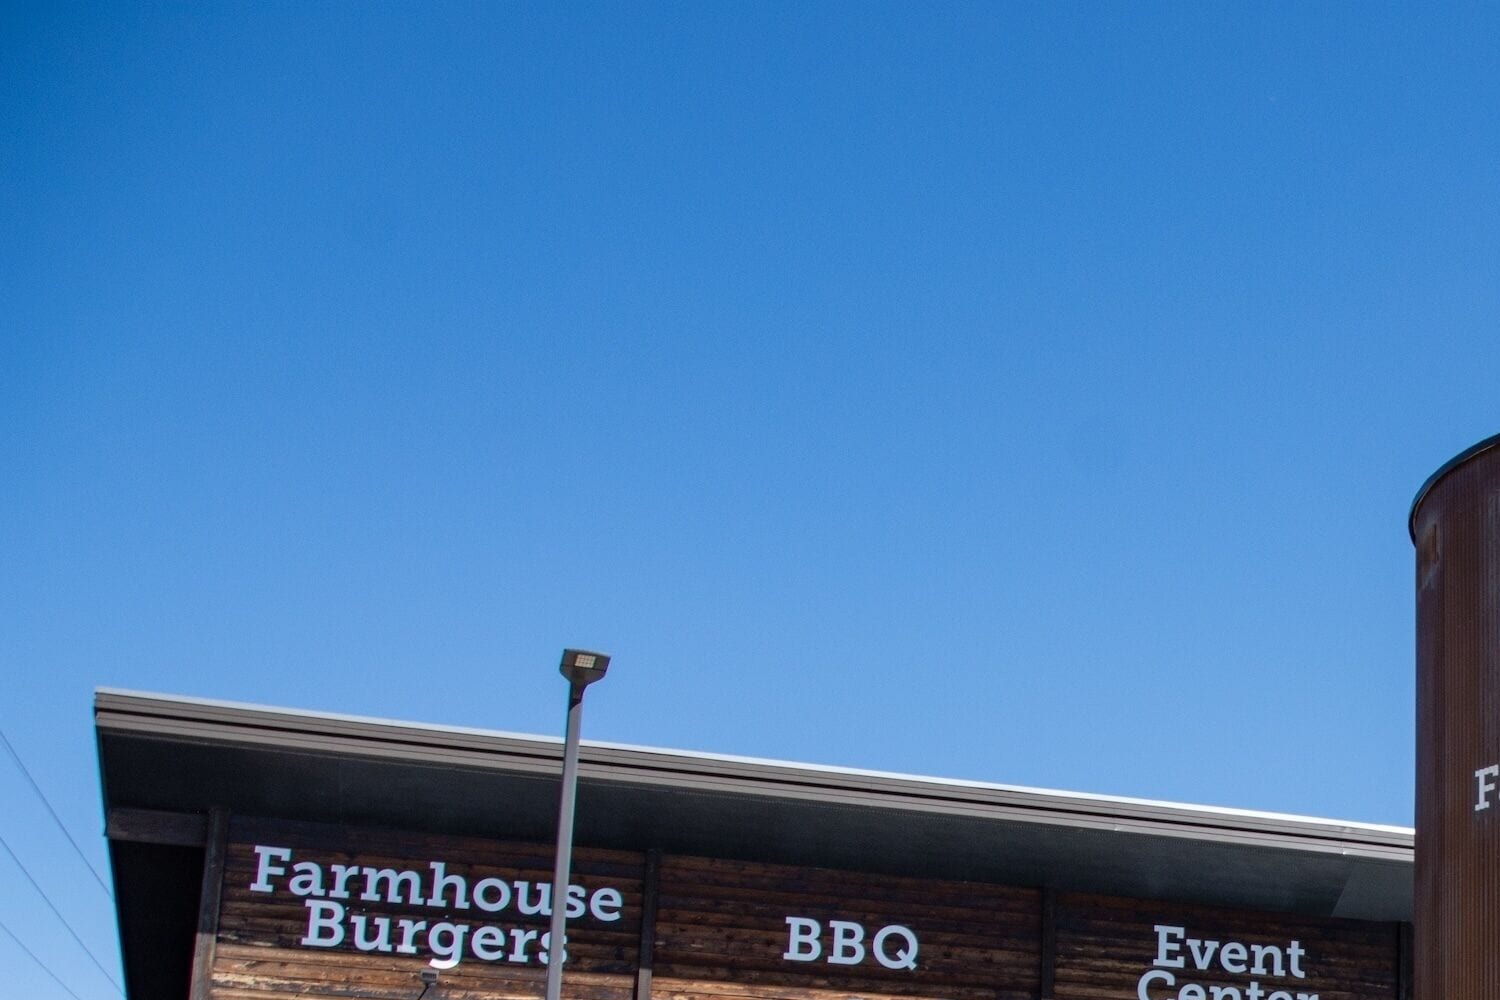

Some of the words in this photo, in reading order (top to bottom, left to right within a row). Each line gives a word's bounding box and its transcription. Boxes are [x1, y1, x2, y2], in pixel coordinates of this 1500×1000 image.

[249, 845, 624, 922] Farmhouse
[783, 916, 919, 971] BBQ
[1153, 924, 1307, 979] Event
